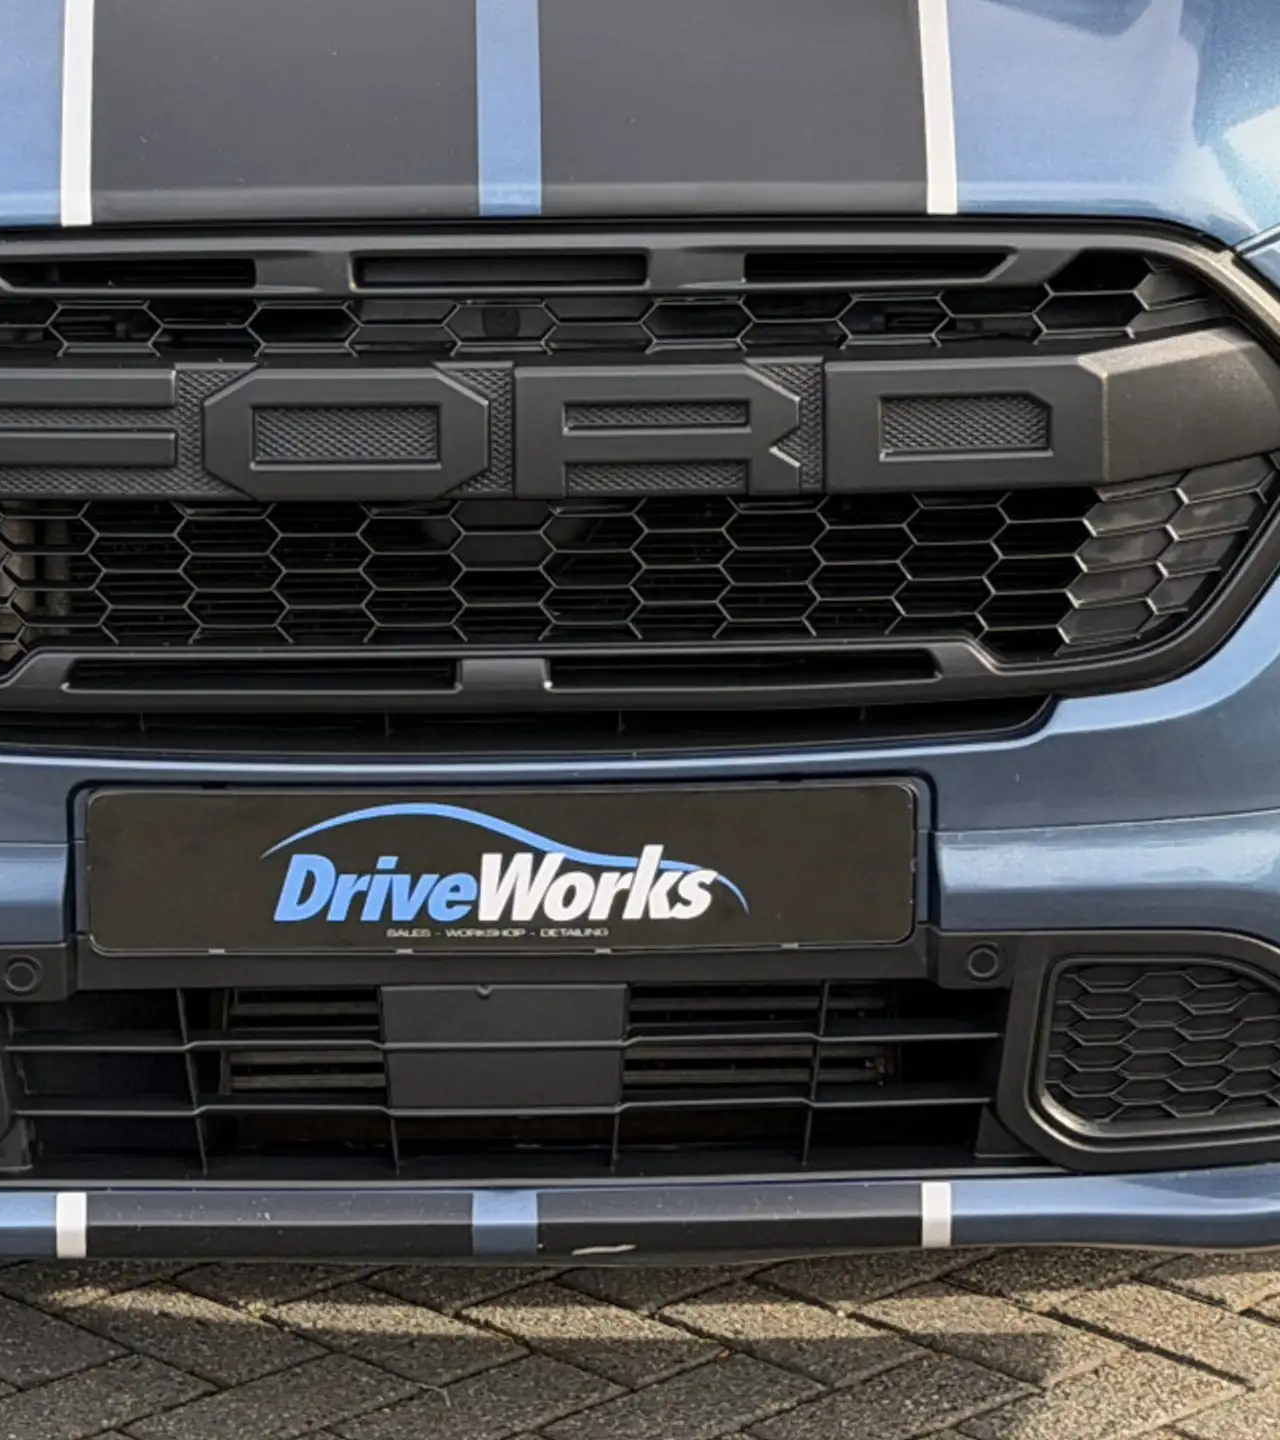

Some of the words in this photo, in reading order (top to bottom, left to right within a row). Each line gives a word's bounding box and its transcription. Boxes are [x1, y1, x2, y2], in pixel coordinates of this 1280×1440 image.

[273, 844, 719, 922] DriveWorks
[386, 928, 431, 937] SALES
[445, 928, 527, 937] WORKSHOP
[540, 928, 608, 937] DETAILING
